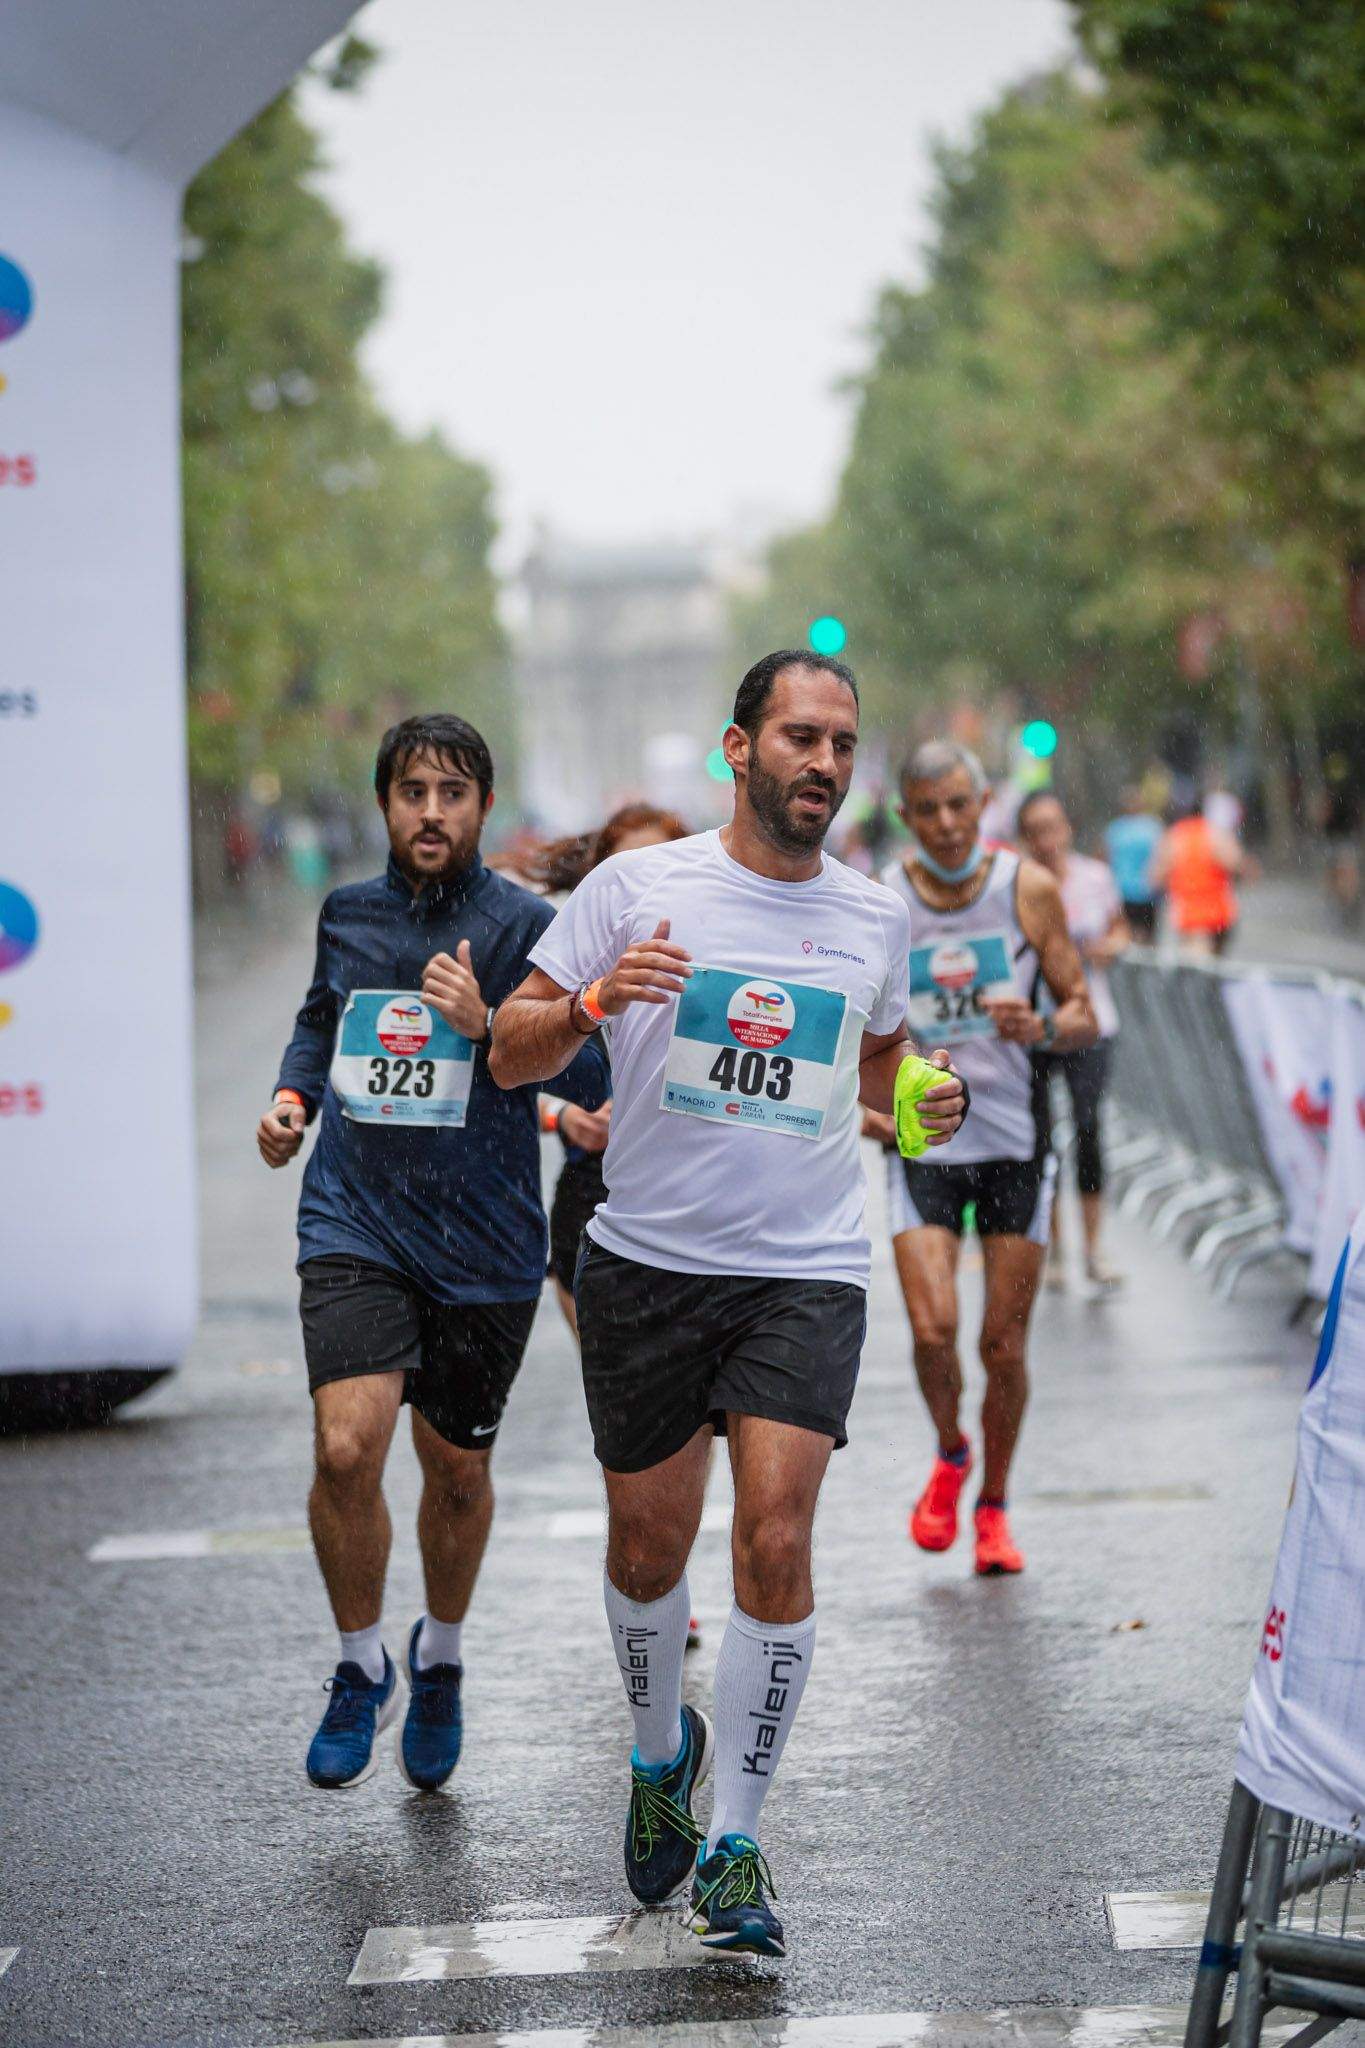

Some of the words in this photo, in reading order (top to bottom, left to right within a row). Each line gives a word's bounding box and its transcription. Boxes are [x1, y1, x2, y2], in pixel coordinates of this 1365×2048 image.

[368, 1057, 436, 1098] 323
[708, 1047, 794, 1101] 403
[678, 1094, 716, 1109] MADRID
[743, 1642, 802, 1776] Kalenji
